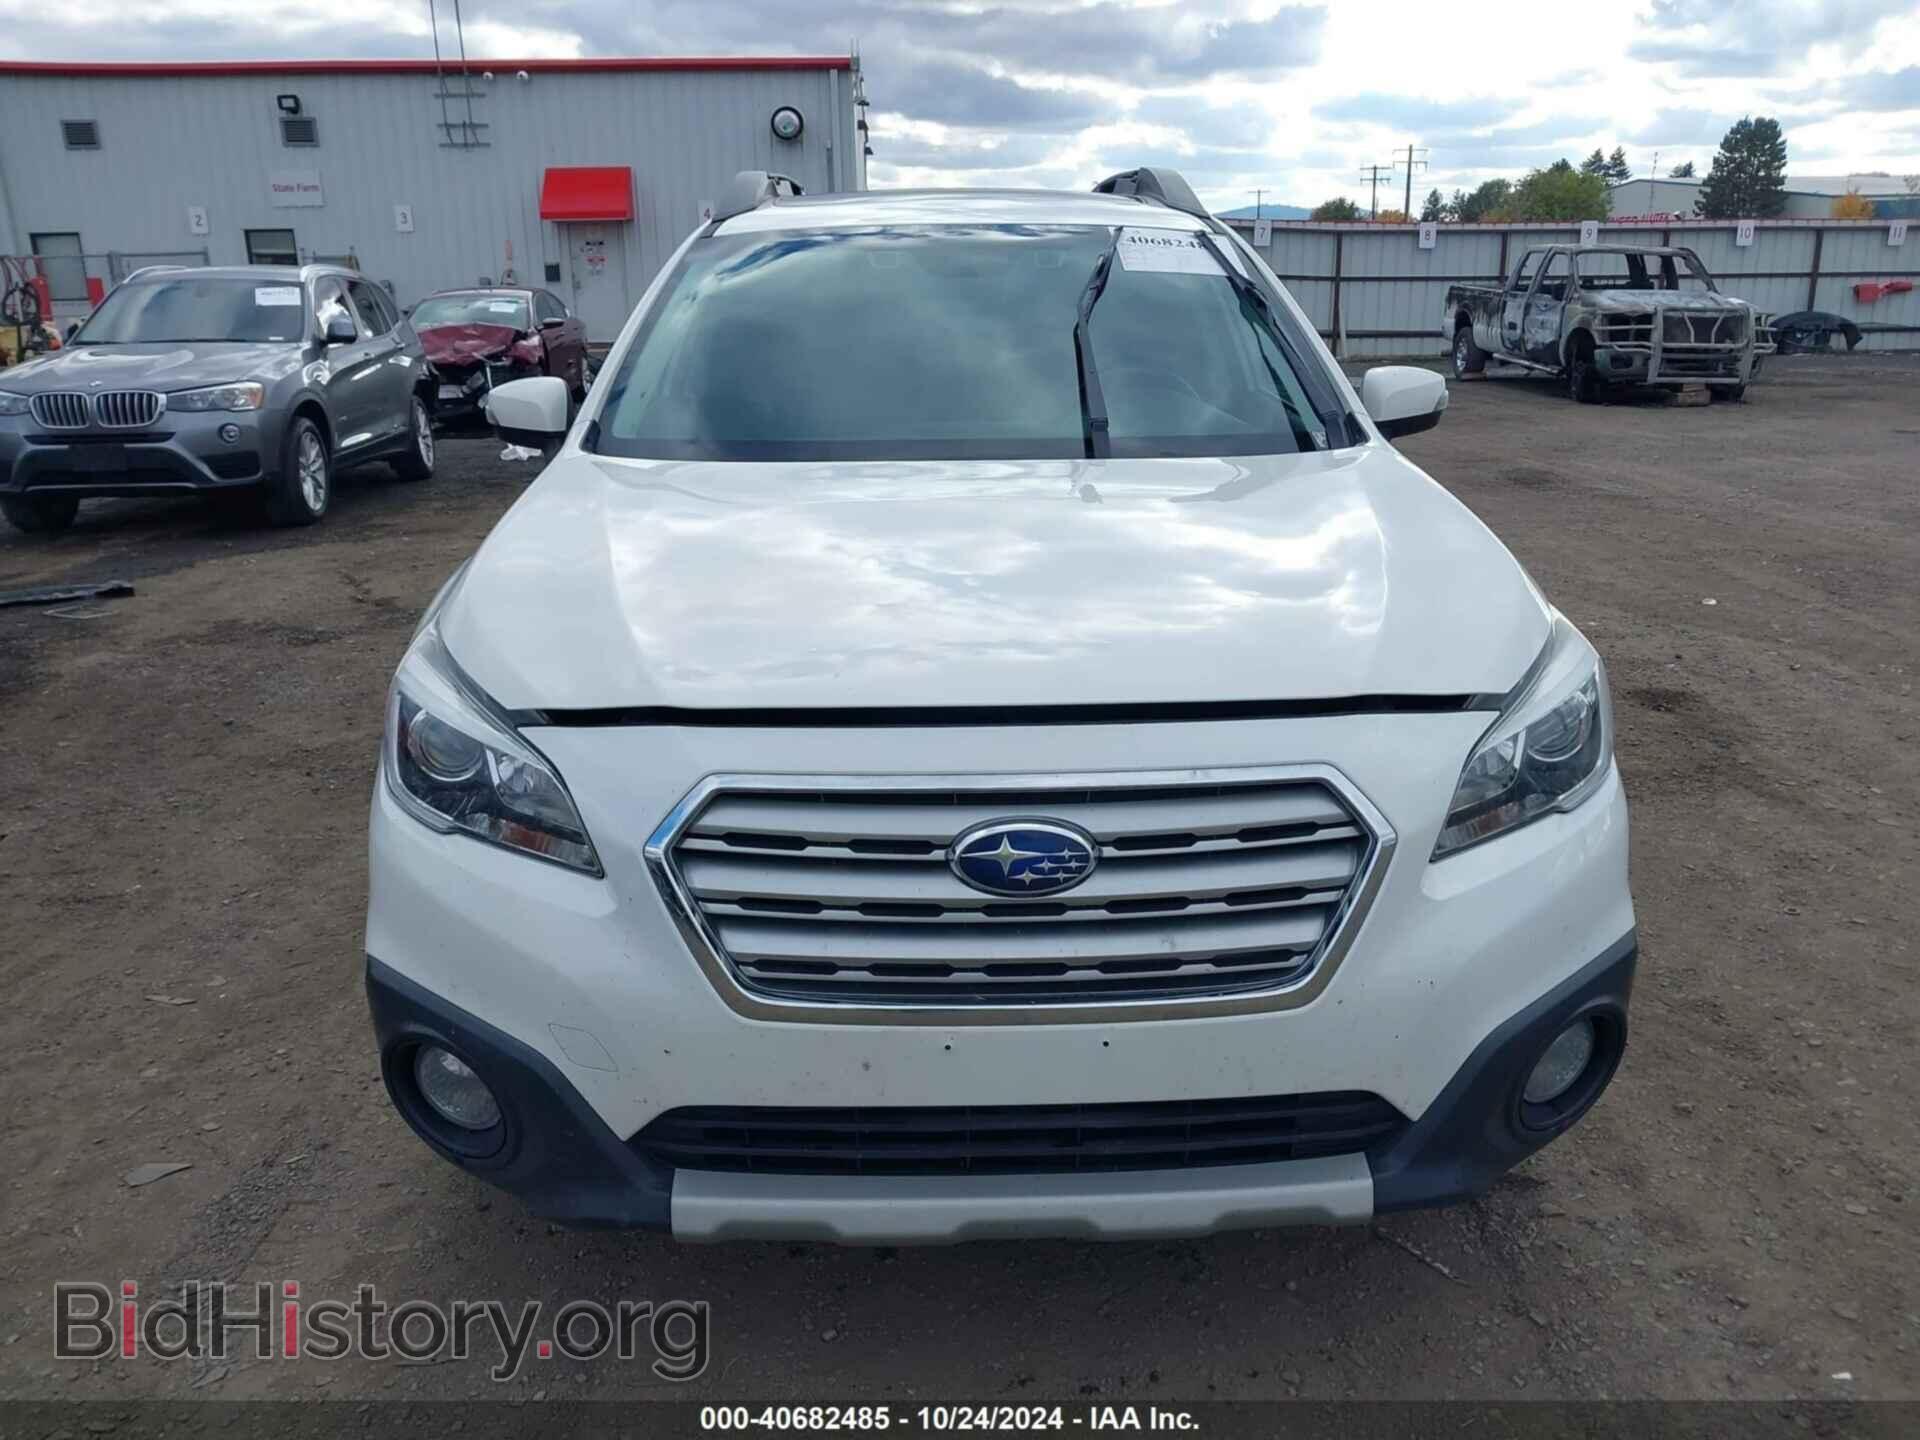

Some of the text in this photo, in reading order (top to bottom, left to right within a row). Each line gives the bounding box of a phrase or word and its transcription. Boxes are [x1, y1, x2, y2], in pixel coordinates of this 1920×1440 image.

[272, 182, 295, 193] State
[399, 211, 408, 225] 3
[703, 207, 711, 220] 4
[195, 214, 204, 227] 2
[1258, 226, 1267, 239] 7
[1424, 230, 1431, 241] 8
[1585, 228, 1593, 239] 9
[1740, 226, 1751, 239] 10
[1893, 225, 1903, 239] 11
